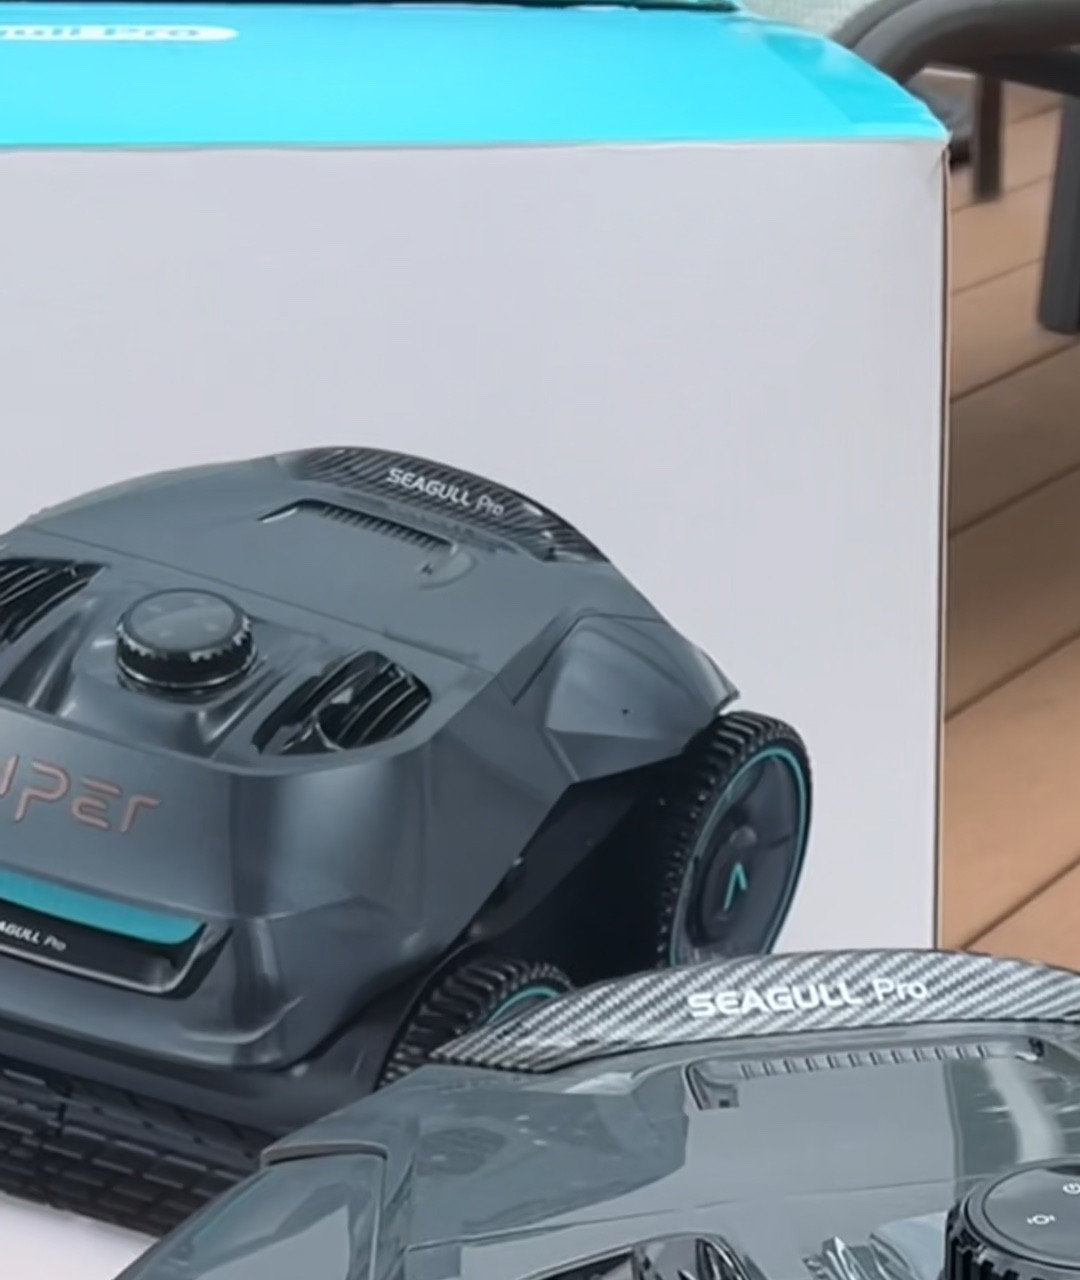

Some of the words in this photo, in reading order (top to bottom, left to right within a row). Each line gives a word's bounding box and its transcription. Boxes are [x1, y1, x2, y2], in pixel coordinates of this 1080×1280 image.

[387, 468, 470, 506] SEAGULL
[474, 494, 504, 516] Pro
[43, 935, 67, 952] Pro
[687, 979, 864, 1018] SEAGULL
[871, 977, 929, 1002] Pro
